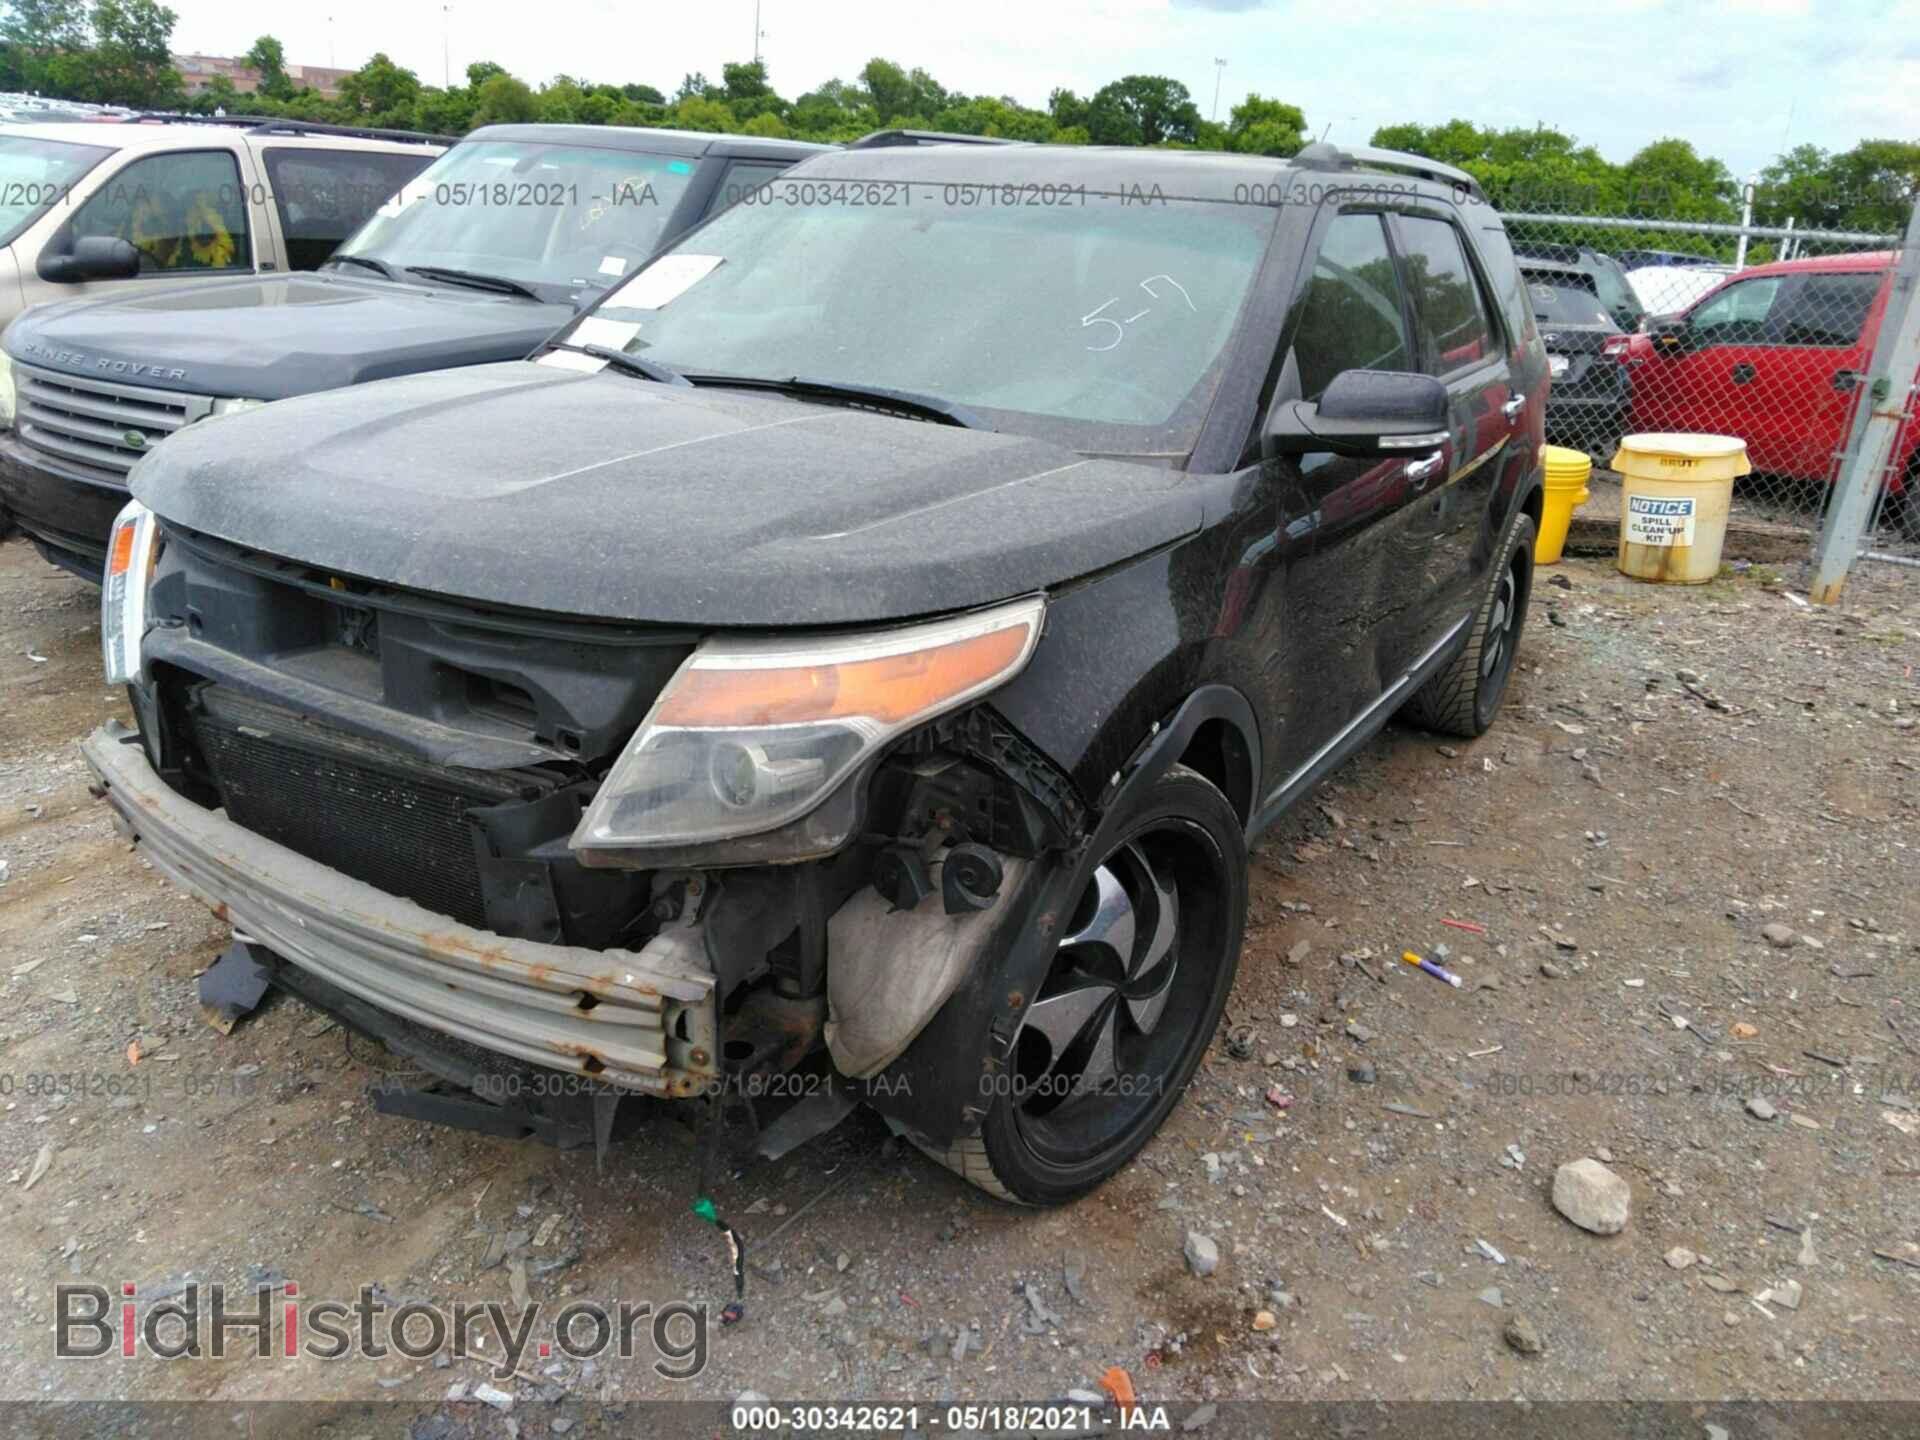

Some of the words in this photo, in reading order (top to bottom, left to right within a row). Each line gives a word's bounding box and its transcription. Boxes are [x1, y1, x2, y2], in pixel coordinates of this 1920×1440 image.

[1081, 274, 1198, 352] 5-7
[96, 357, 186, 380] ROVER
[1631, 498, 1691, 515] NOTICE
[1641, 516, 1673, 526] SPILL
[1645, 534, 1665, 543] KIT
